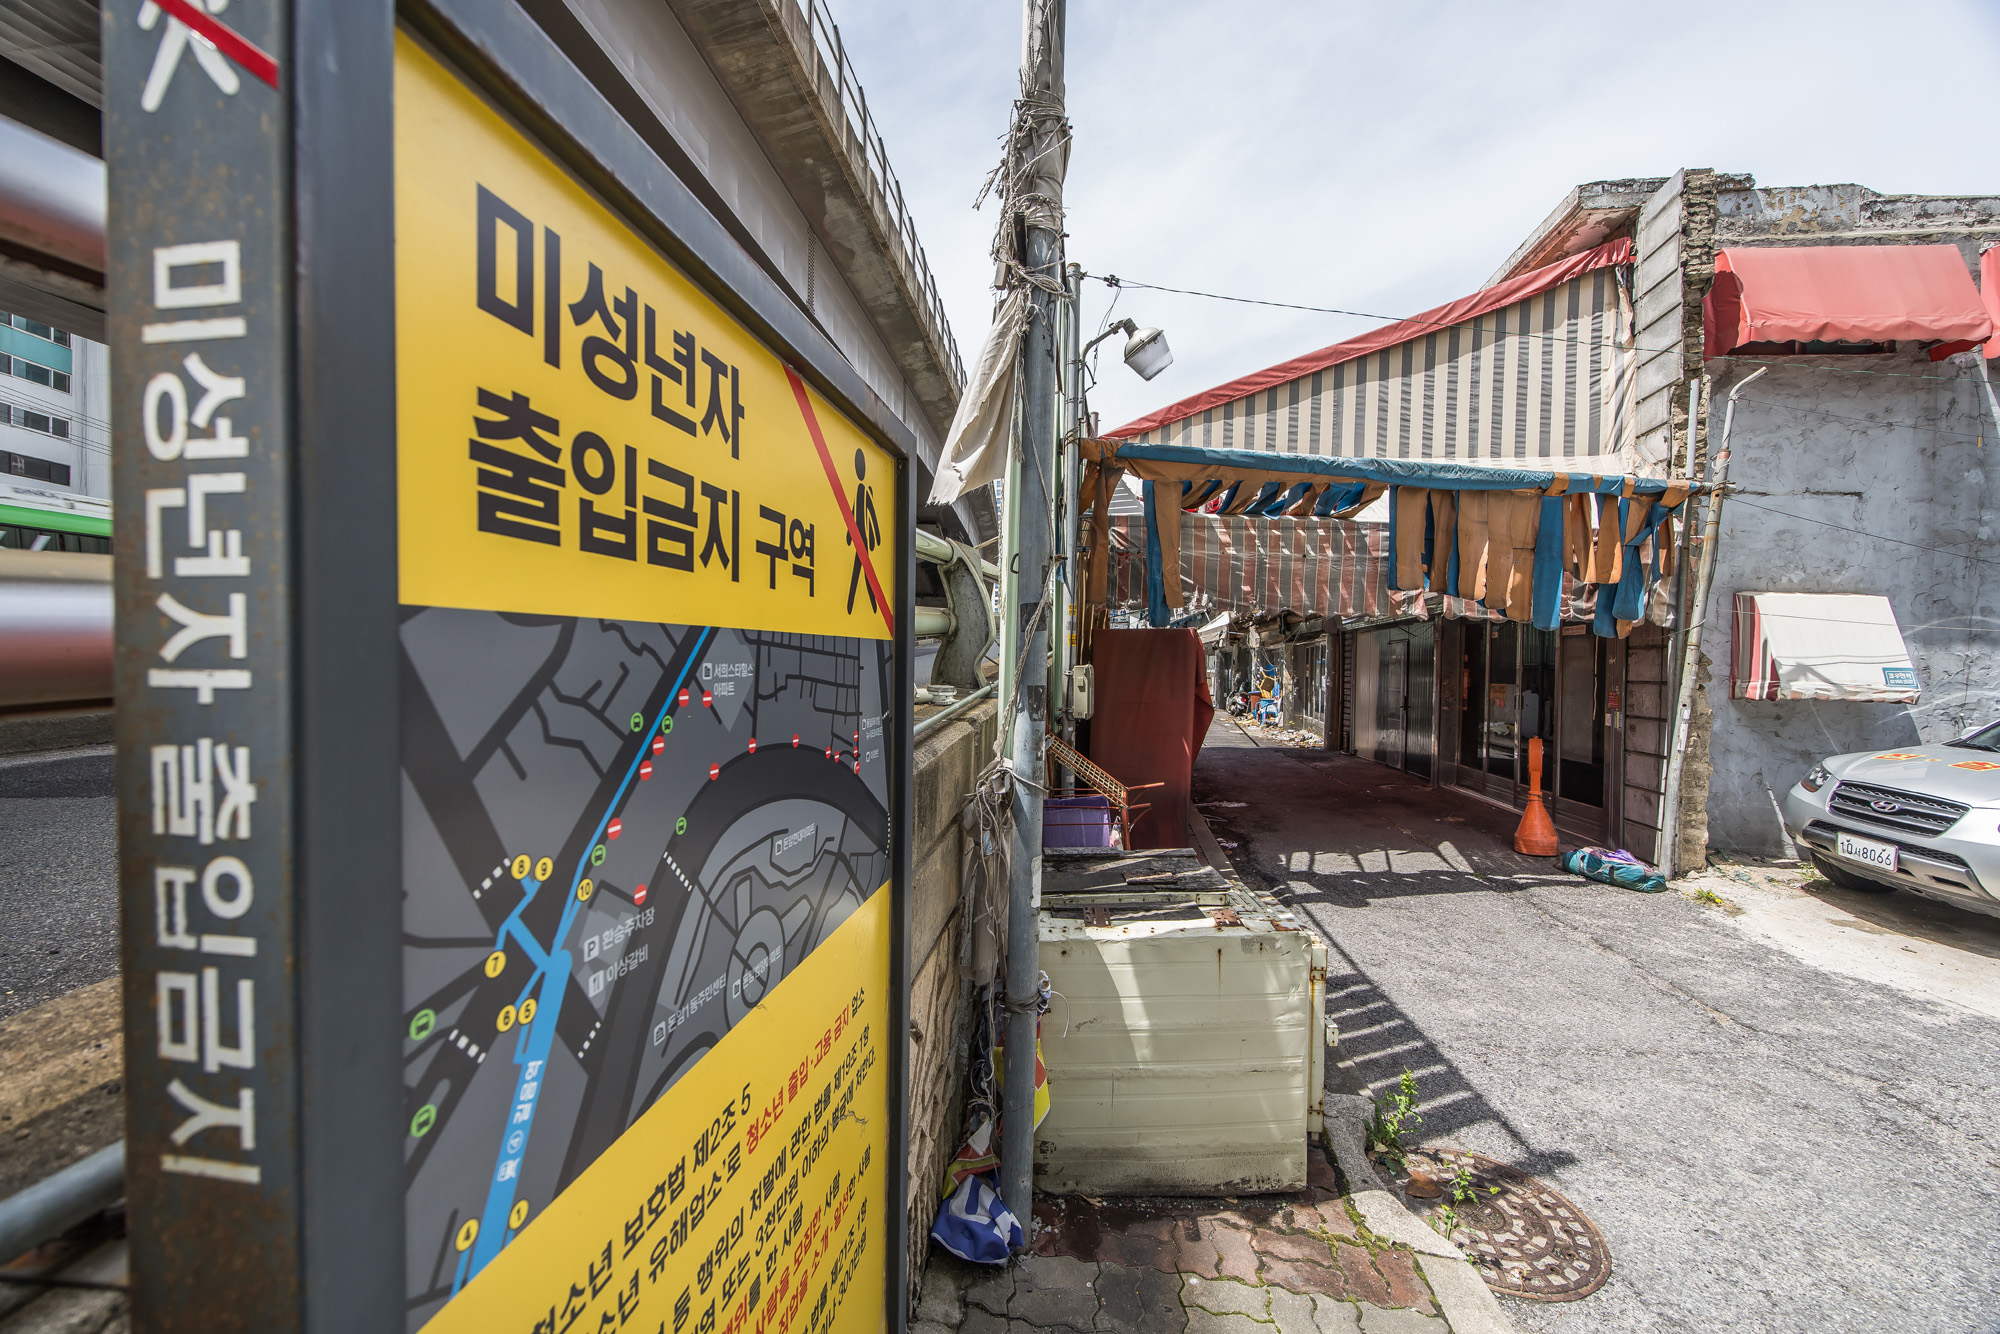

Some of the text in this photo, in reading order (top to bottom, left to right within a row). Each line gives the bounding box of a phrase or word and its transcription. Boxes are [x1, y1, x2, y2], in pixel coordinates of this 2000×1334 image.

[476, 181, 745, 461] 미성년자
[469, 386, 815, 597] 출입금지 구역
[142, 239, 261, 1184] 미성년자 출입금지
[713, 663, 754, 678] 서희스타힐스
[713, 681, 735, 697] 아파트
[579, 882, 592, 898] 10
[1840, 841, 1892, 866] 10서8066
[602, 906, 656, 951] 환승주차장
[667, 972, 728, 1034] 돈암1동주민센터
[746, 1086, 784, 1155] 청소년
[834, 1003, 850, 1042] 금지
[852, 986, 865, 1019] 업소
[513, 1060, 544, 1125] 길음역
[622, 1155, 686, 1261] 보호법
[693, 1099, 736, 1173] 제2조
[741, 1082, 752, 1116] 5
[673, 1023, 870, 1334] 등 행위의 처벌에 관한 법률 제19조 1항
[721, 1250, 751, 1313] 또는
[755, 1168, 799, 1257] 3천만원
[802, 1119, 829, 1178] 이하의
[832, 1078, 854, 1133] 벌금에
[855, 1045, 876, 1091] 처한다.
[778, 1269, 808, 1334] 직업을
[858, 1143, 872, 1183] 사람
[756, 1169, 841, 1334] 사람을 모집한 사람
[765, 1243, 779, 1285] 한
[781, 1201, 804, 1256] 사람
[811, 1197, 868, 1334] 법률 제21조 1항
[820, 1226, 867, 1334] 이나 300만원
